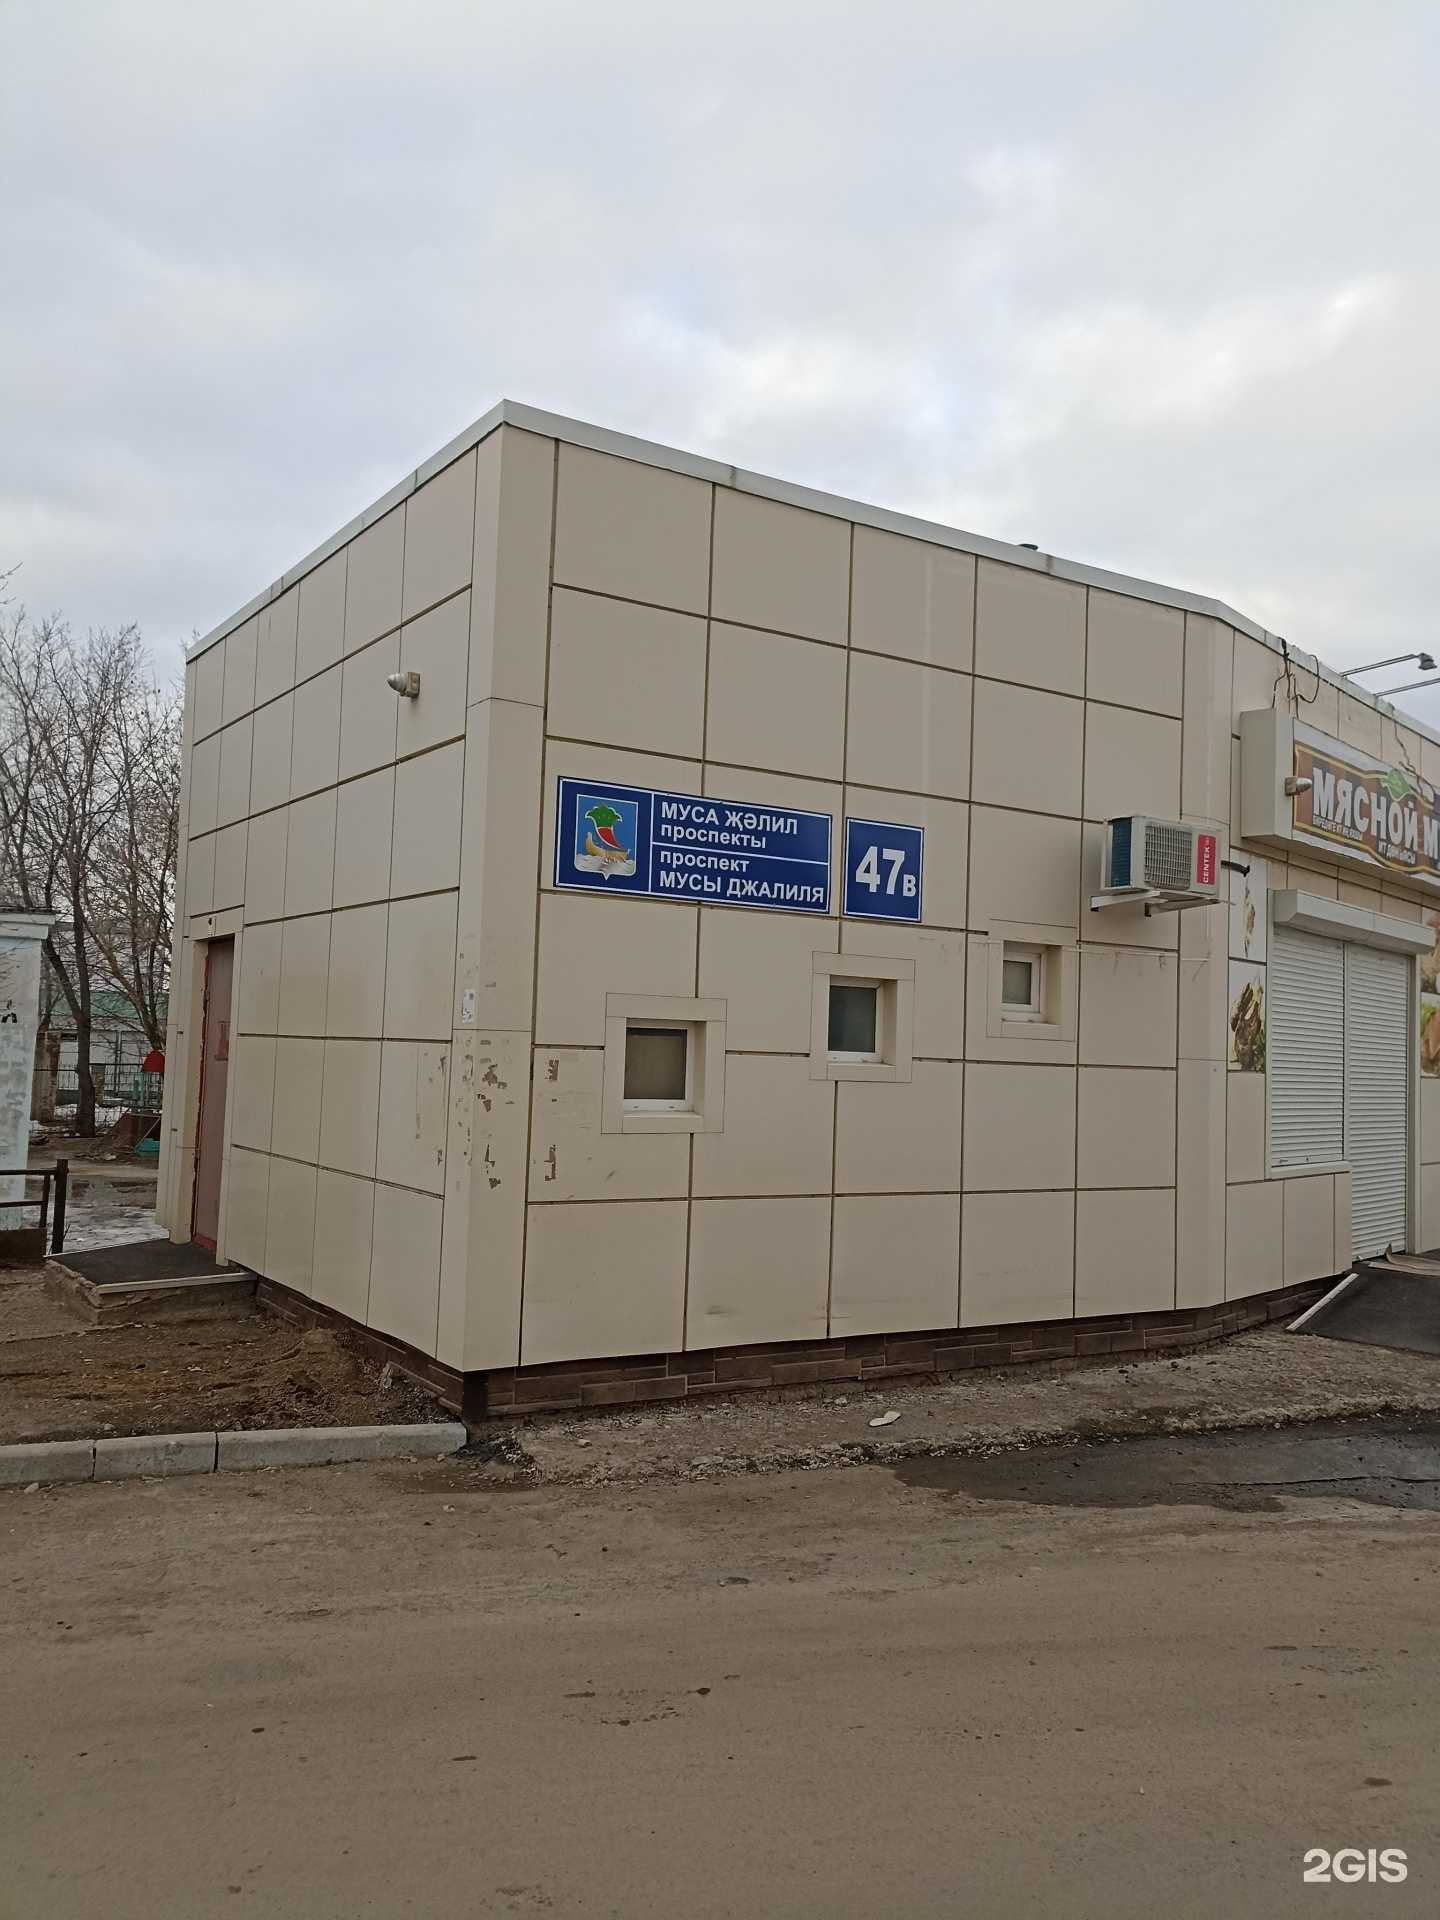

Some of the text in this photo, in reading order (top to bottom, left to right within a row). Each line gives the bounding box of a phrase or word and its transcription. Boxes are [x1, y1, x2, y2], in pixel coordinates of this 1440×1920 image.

[661, 801, 798, 835] МУСА ҖӘЛИЛ
[1312, 767, 1418, 852] МЯСНОЙ
[660, 824, 767, 849] проспекты
[660, 851, 750, 873] проспект
[659, 870, 824, 903] МУСЫ ДЖАЛИЛЯ
